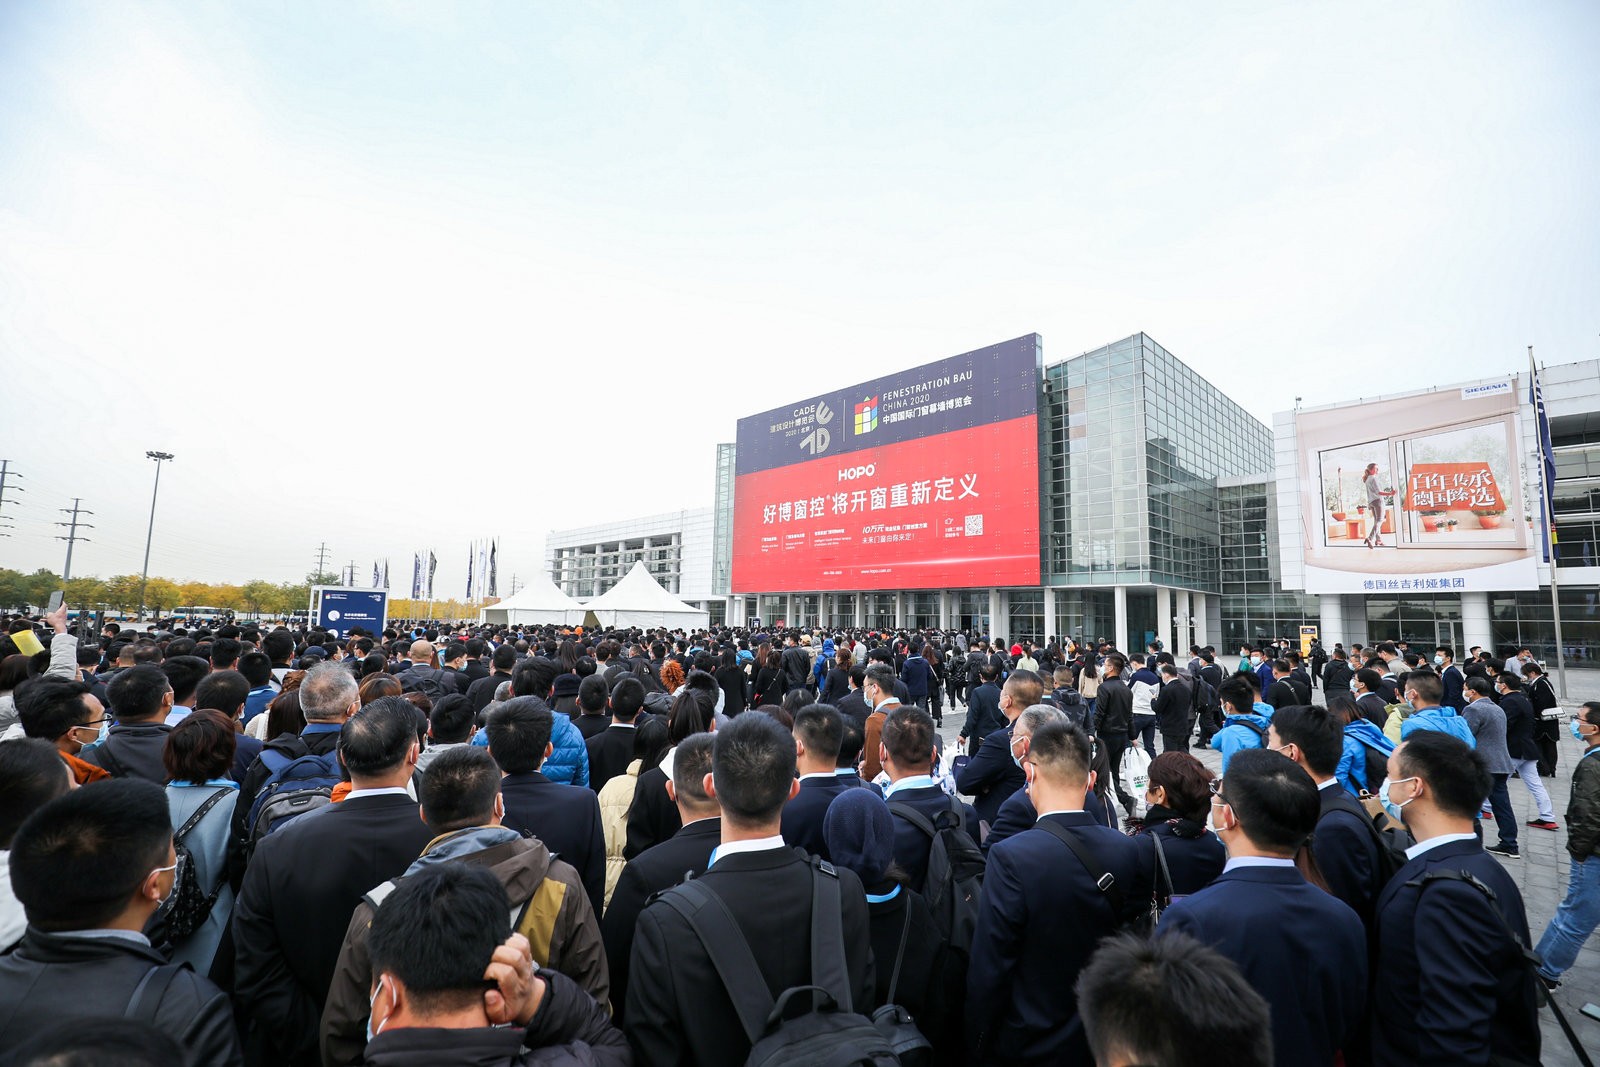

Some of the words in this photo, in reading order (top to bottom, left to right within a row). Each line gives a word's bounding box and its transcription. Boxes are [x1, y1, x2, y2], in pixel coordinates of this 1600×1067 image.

[883, 377, 949, 401] FENESTRATION
[953, 370, 973, 383] BAU
[1465, 383, 1508, 394] SIEGENIA
[793, 404, 816, 418] CADE
[882, 395, 973, 425] 中国国际门窗幕墙博览会
[883, 399, 908, 412] CHINA
[910, 393, 930, 406] 2020
[1411, 469, 1493, 491] 百年传承
[1412, 487, 1496, 508] 德国臻选
[1363, 577, 1465, 590] 德国丝吉利娅集团
